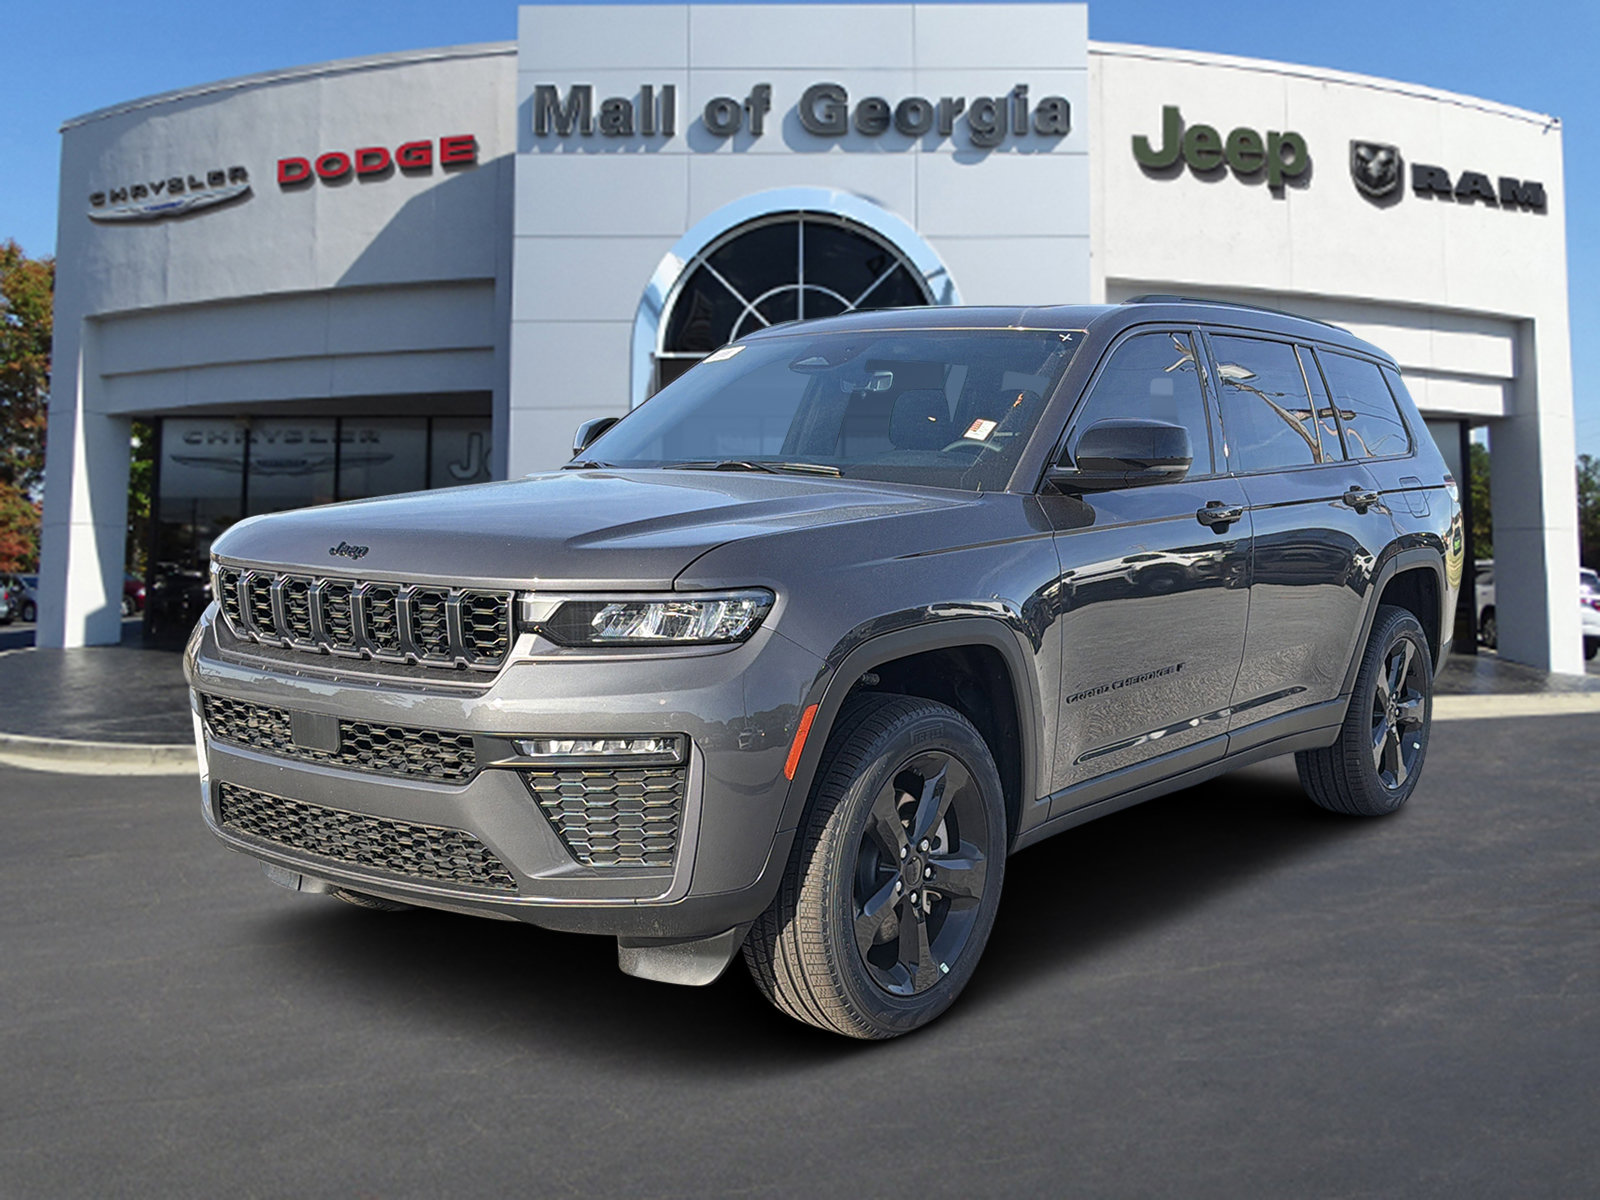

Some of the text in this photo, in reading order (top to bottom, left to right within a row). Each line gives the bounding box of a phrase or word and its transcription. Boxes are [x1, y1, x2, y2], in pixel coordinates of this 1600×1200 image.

[531, 82, 1073, 148] Mall of Georgia
[277, 134, 477, 188] DODGE
[1131, 105, 1309, 192] Jeep
[89, 165, 249, 207] CHRYSLER
[1411, 162, 1546, 213] RAM
[328, 541, 369, 560] Jeep
